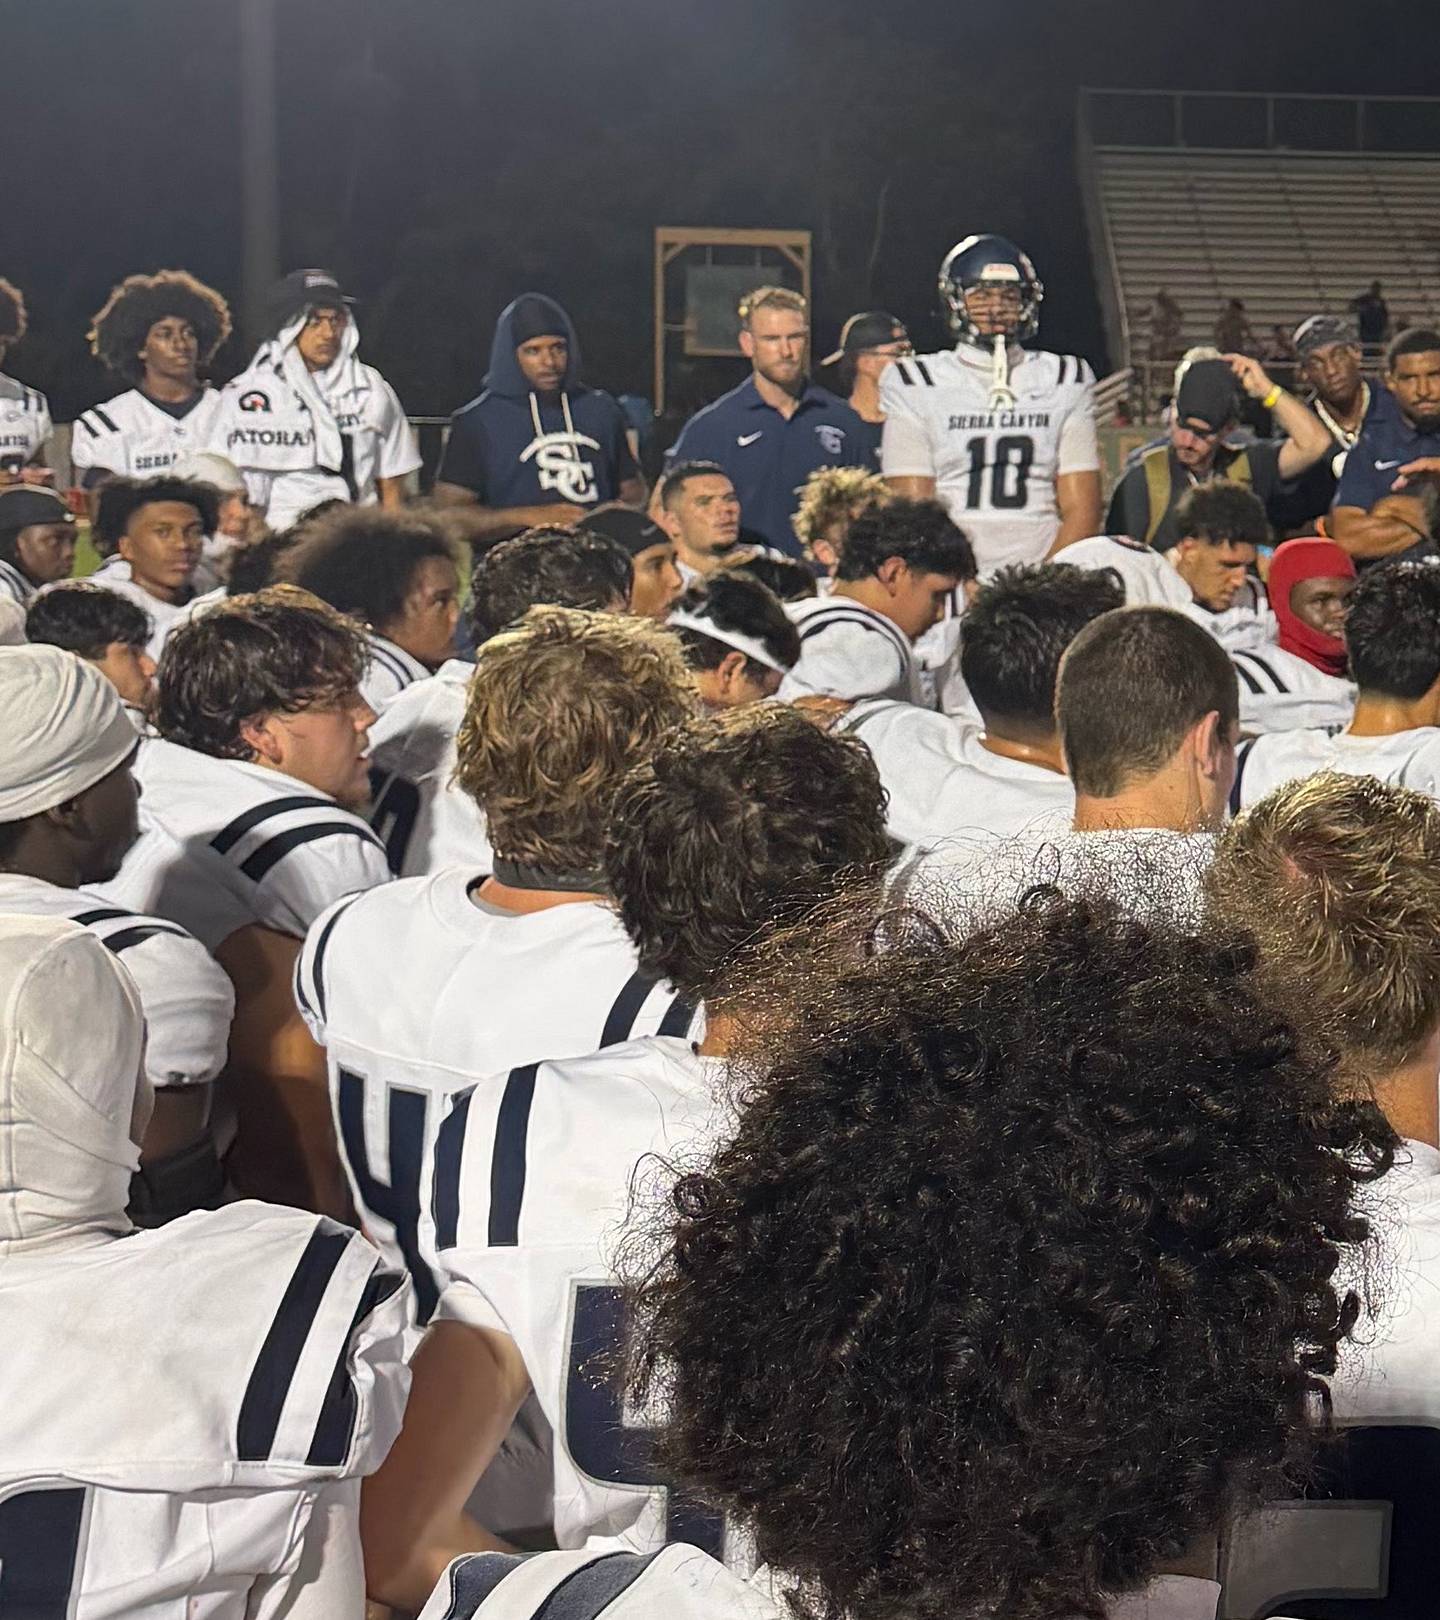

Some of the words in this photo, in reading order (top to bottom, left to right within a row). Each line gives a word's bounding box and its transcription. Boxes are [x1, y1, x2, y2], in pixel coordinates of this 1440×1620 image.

[949, 414, 994, 430] SIERRA
[1000, 412, 1050, 428] CANYON
[519, 431, 601, 503] SC
[965, 436, 1034, 509] 10
